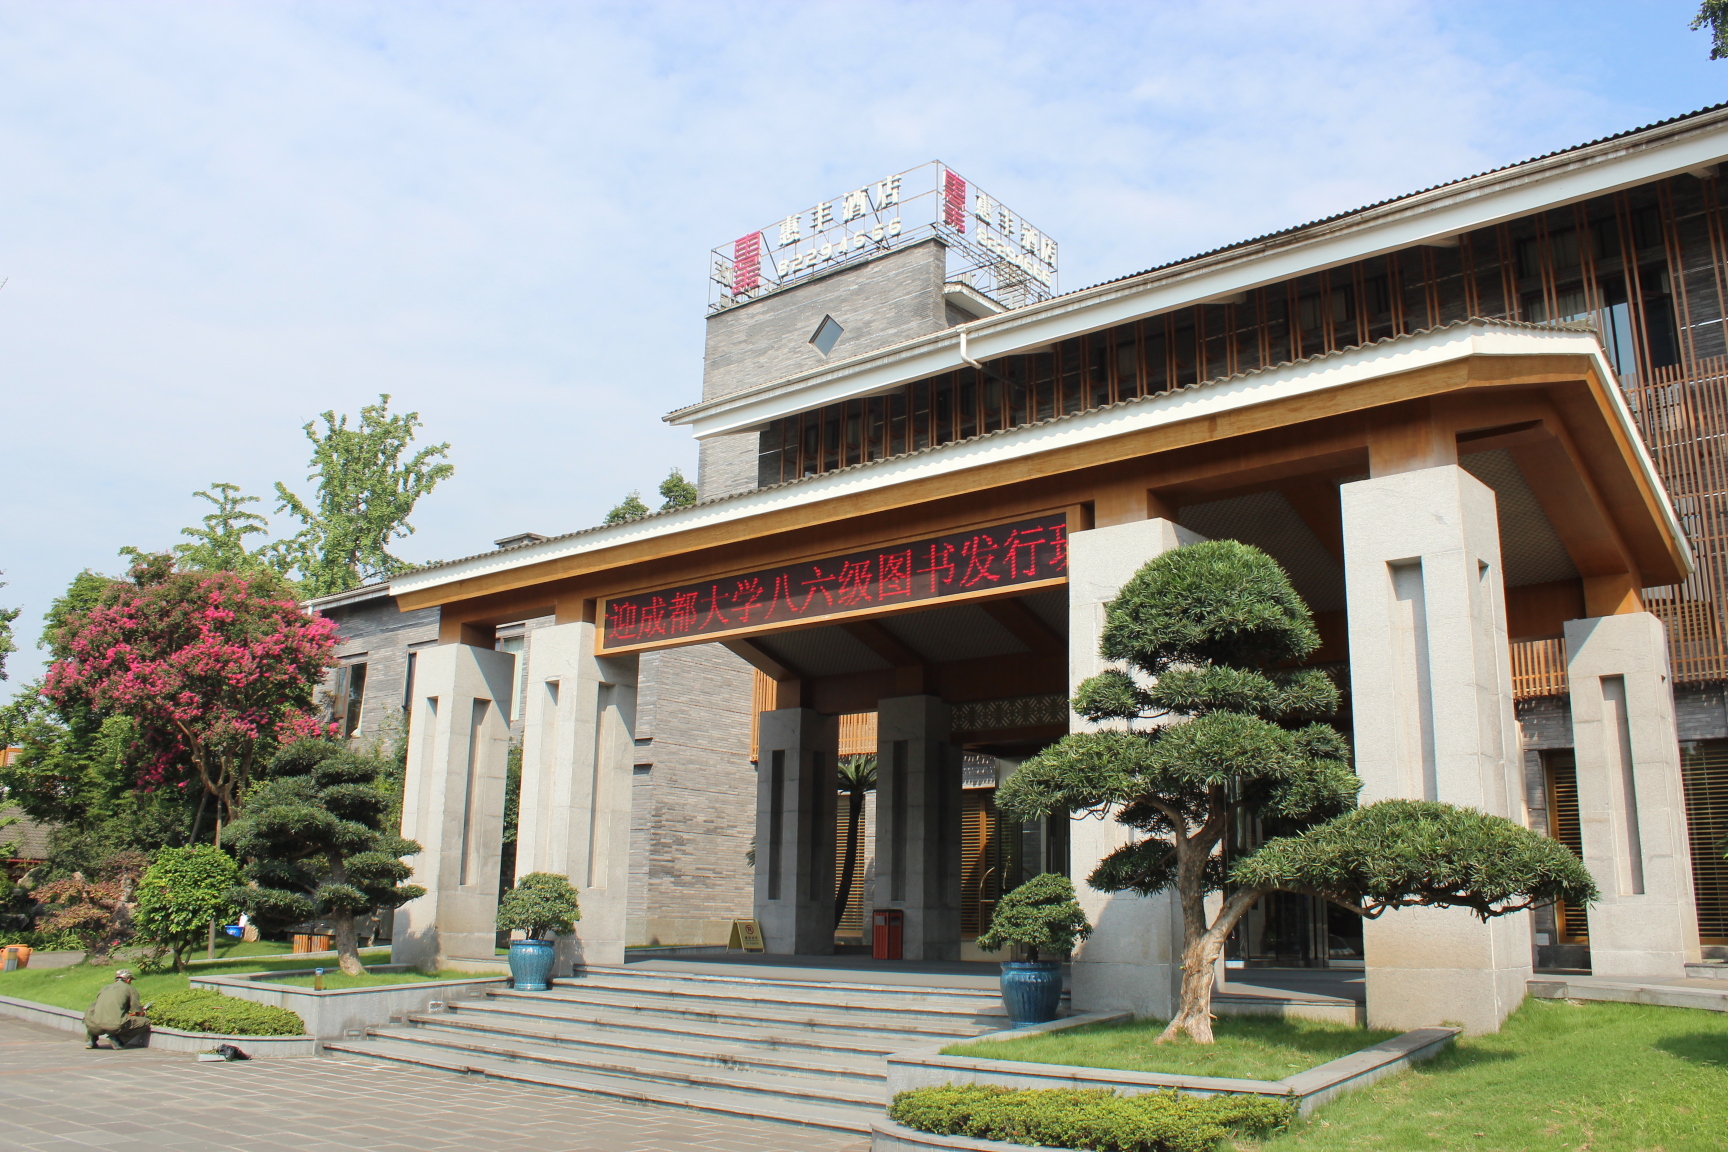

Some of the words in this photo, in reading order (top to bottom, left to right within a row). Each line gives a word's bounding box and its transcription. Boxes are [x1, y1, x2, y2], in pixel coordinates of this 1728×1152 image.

[778, 174, 902, 247] 惠丰酒店
[778, 216, 902, 278] 82294666
[604, 523, 1067, 642] 迎成都大学八六级图书发行
